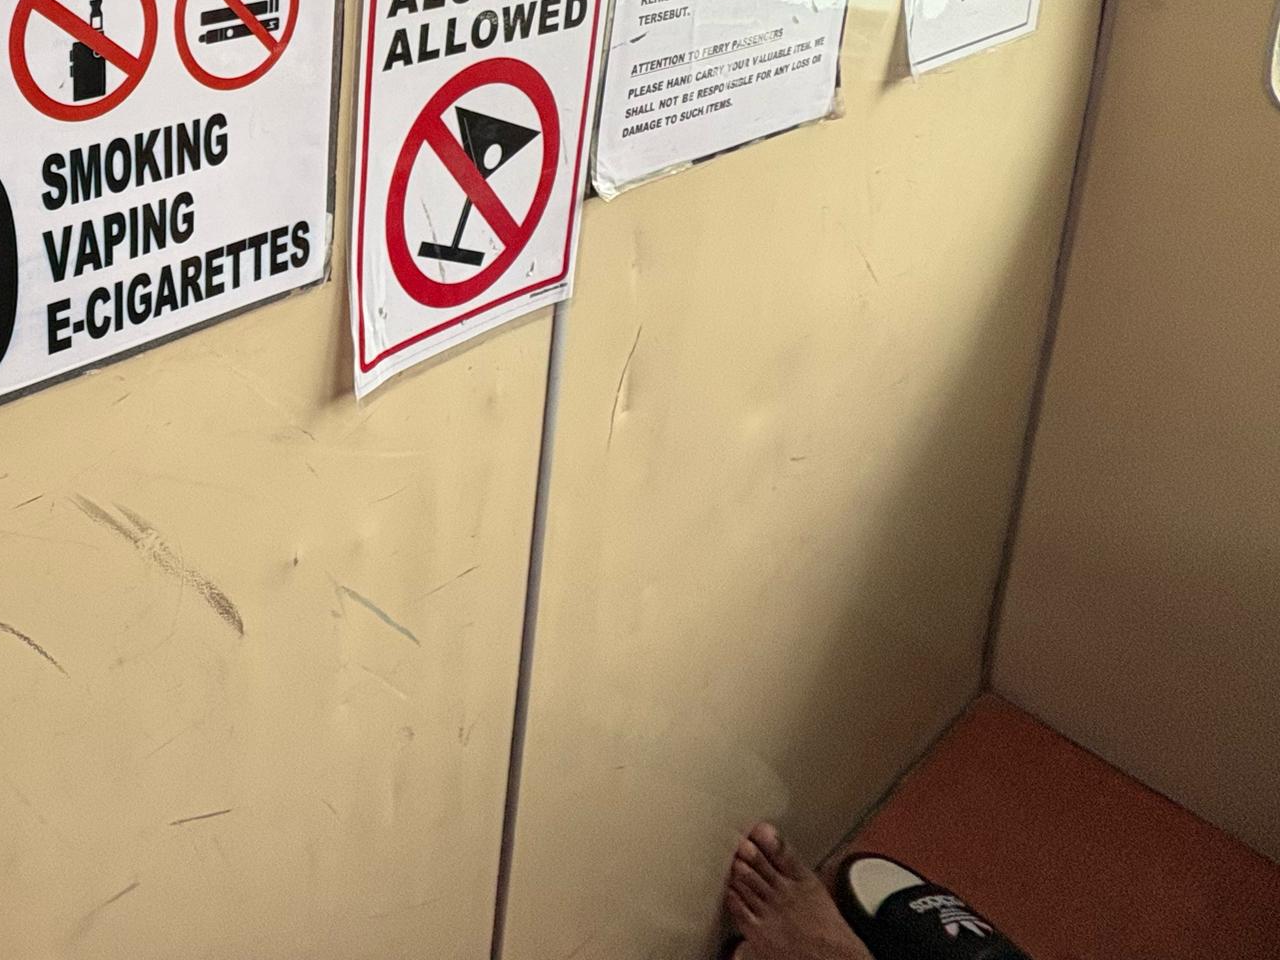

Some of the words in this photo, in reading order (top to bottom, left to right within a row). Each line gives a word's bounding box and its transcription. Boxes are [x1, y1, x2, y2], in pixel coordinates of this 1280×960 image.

[638, 7, 691, 26] TERSEBUT.
[628, 81, 664, 99] PLEASE
[667, 74, 693, 89] HAND
[695, 64, 724, 81] CARRY
[726, 58, 750, 73] YOUR
[752, 45, 791, 66] VALUABLE
[631, 52, 685, 76] ATTENTION
[688, 49, 700, 61] TO
[702, 41, 730, 57] FERRY
[625, 103, 655, 119] SHALL
[658, 95, 678, 110] NOT
[682, 92, 694, 104] BE
[756, 71, 772, 84] FOR
[773, 65, 791, 77] ANY
[791, 58, 810, 71] LOSS
[622, 118, 662, 138] DAMAGE
[665, 112, 677, 126] TO
[680, 107, 704, 122] SUCH
[706, 98, 733, 115] ITEMS.
[41, 113, 229, 212] SMOKING
[42, 192, 196, 283] VAPING
[47, 220, 311, 356] E-CIGARETTES
